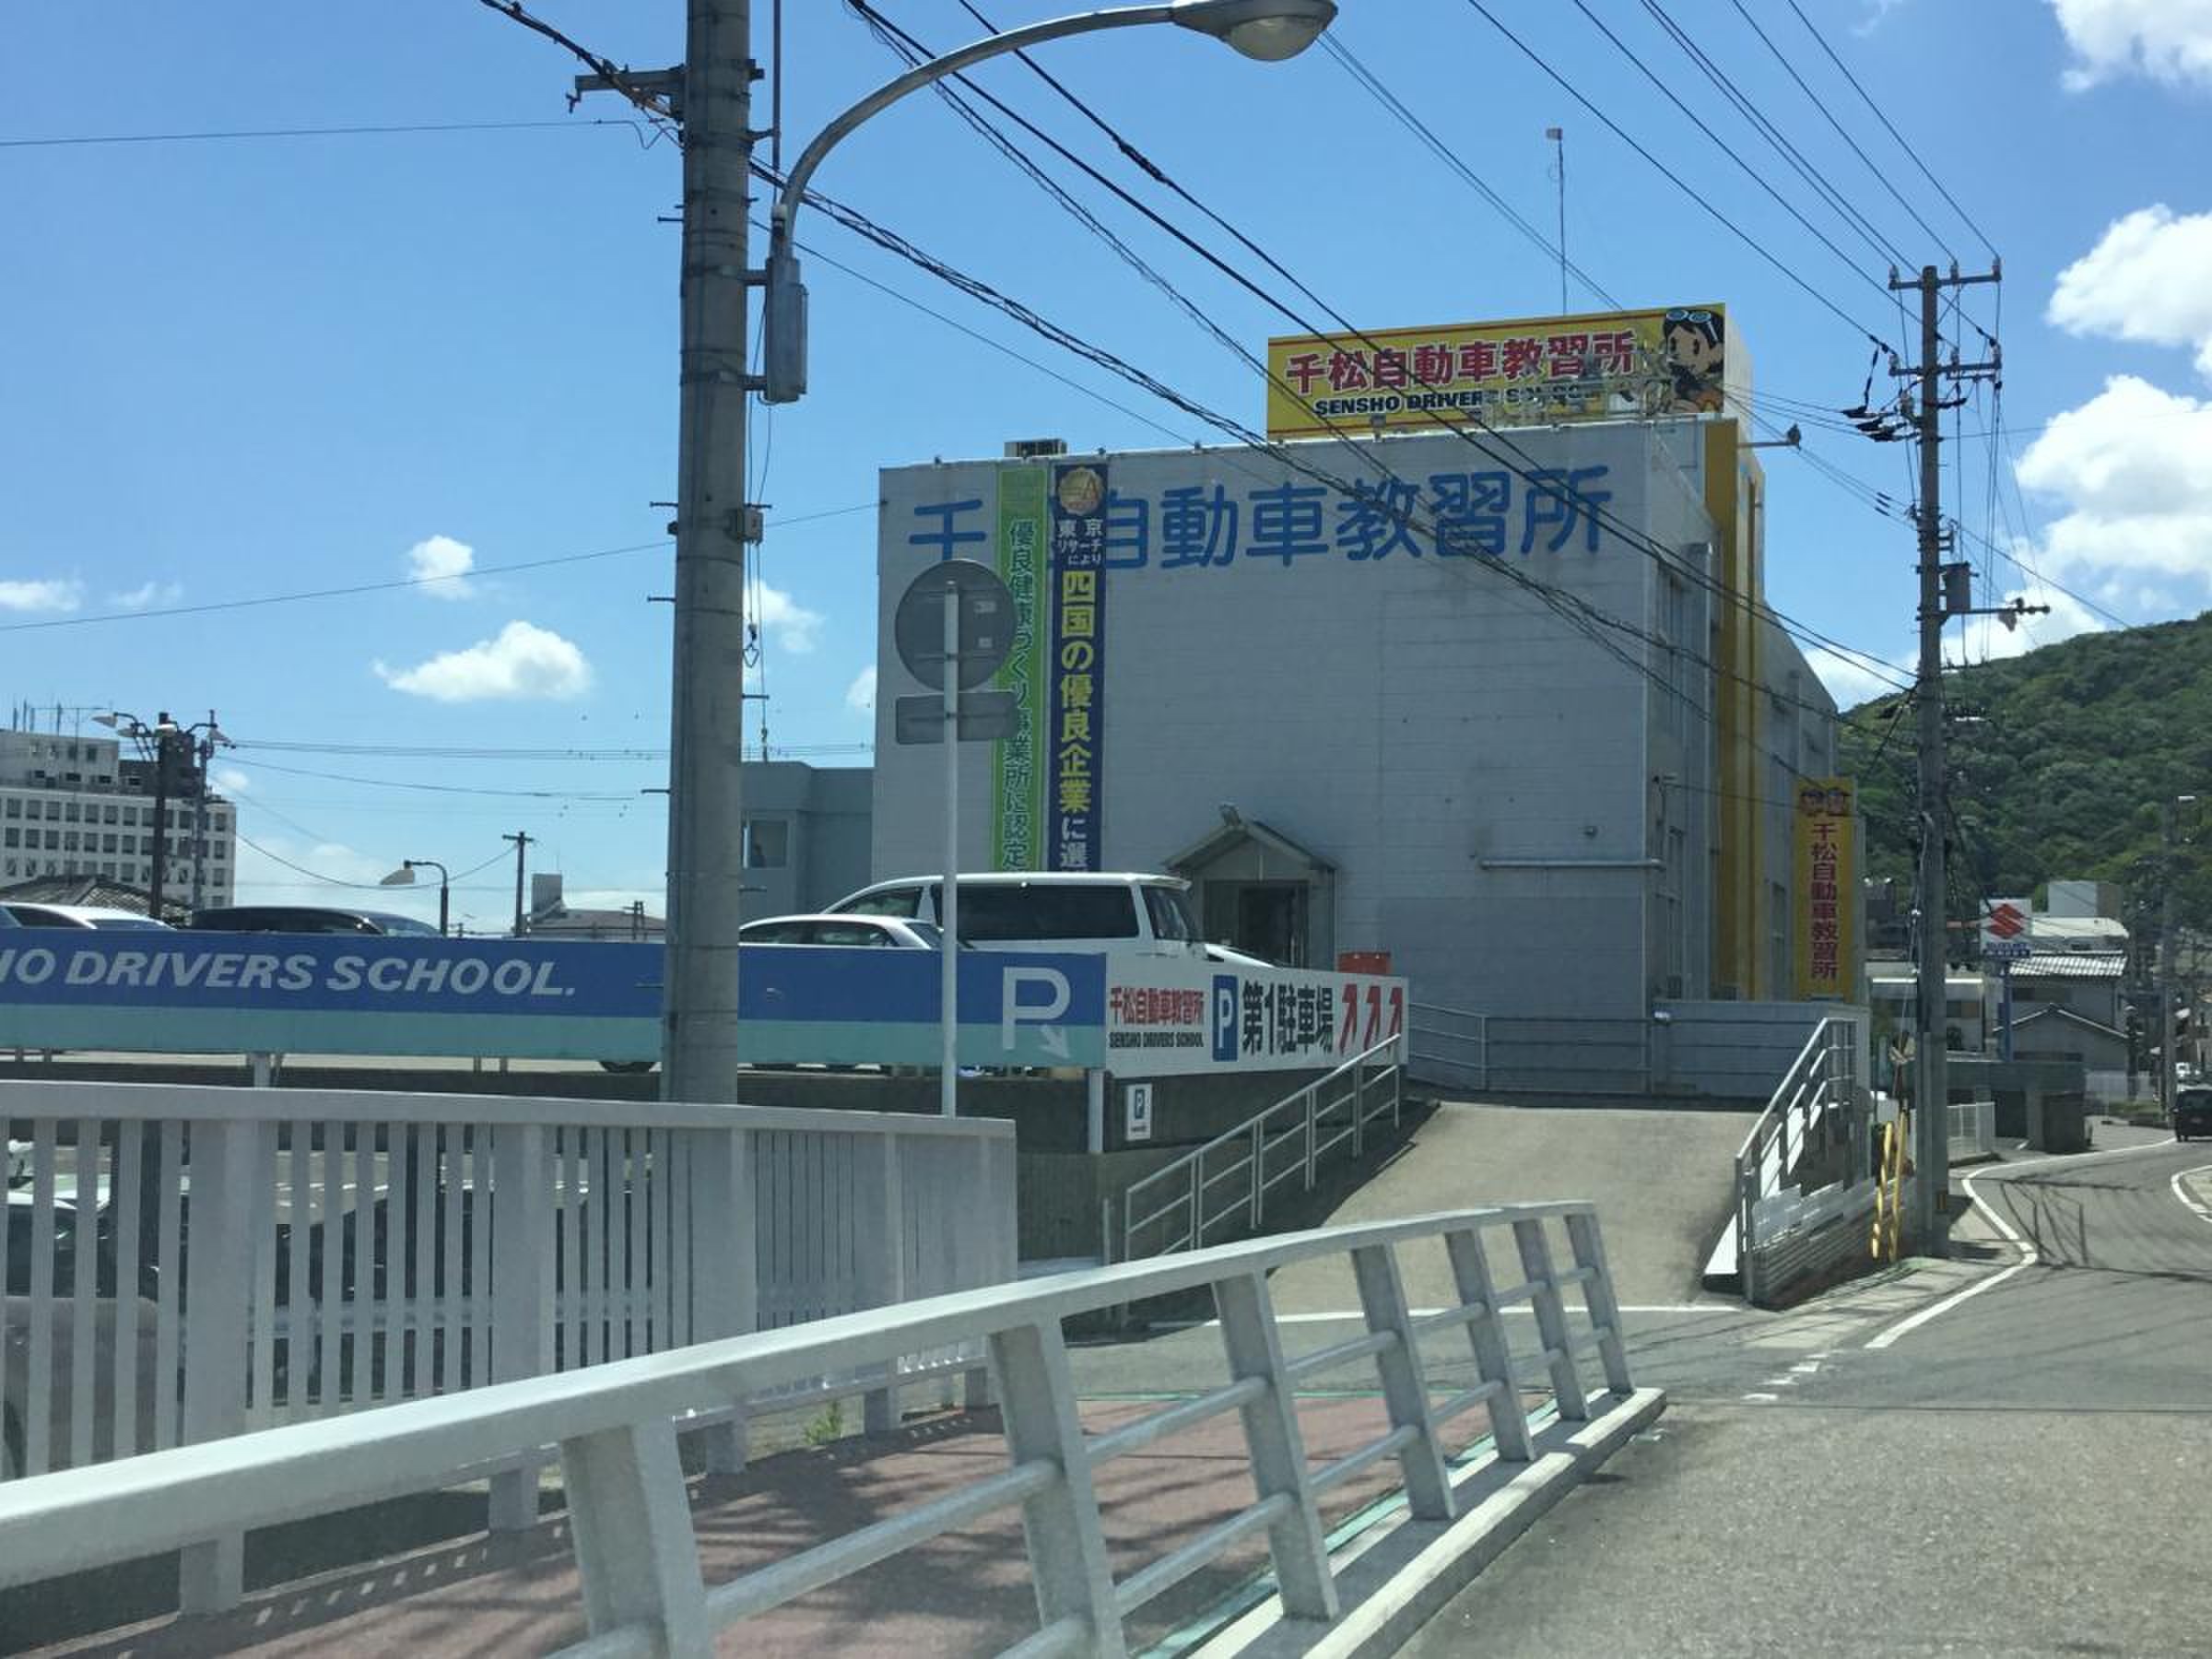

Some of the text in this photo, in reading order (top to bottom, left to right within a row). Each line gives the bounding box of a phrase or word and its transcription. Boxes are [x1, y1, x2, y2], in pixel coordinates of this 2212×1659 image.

[1288, 331, 1637, 396] 千松自動車教習所
[1315, 395, 1400, 417] SENSHO
[910, 465, 1613, 570] 千自動車教習所
[1811, 823, 1838, 980] 千松自動車教習所
[65, 951, 317, 990] DRIVERS
[326, 957, 576, 996] SCHOOL.
[1110, 987, 1205, 1025] 千松自動車教習所
[1003, 966, 1070, 1049] P
[1218, 988, 1234, 1049] P
[1242, 980, 1334, 1055] 第1駐車場
